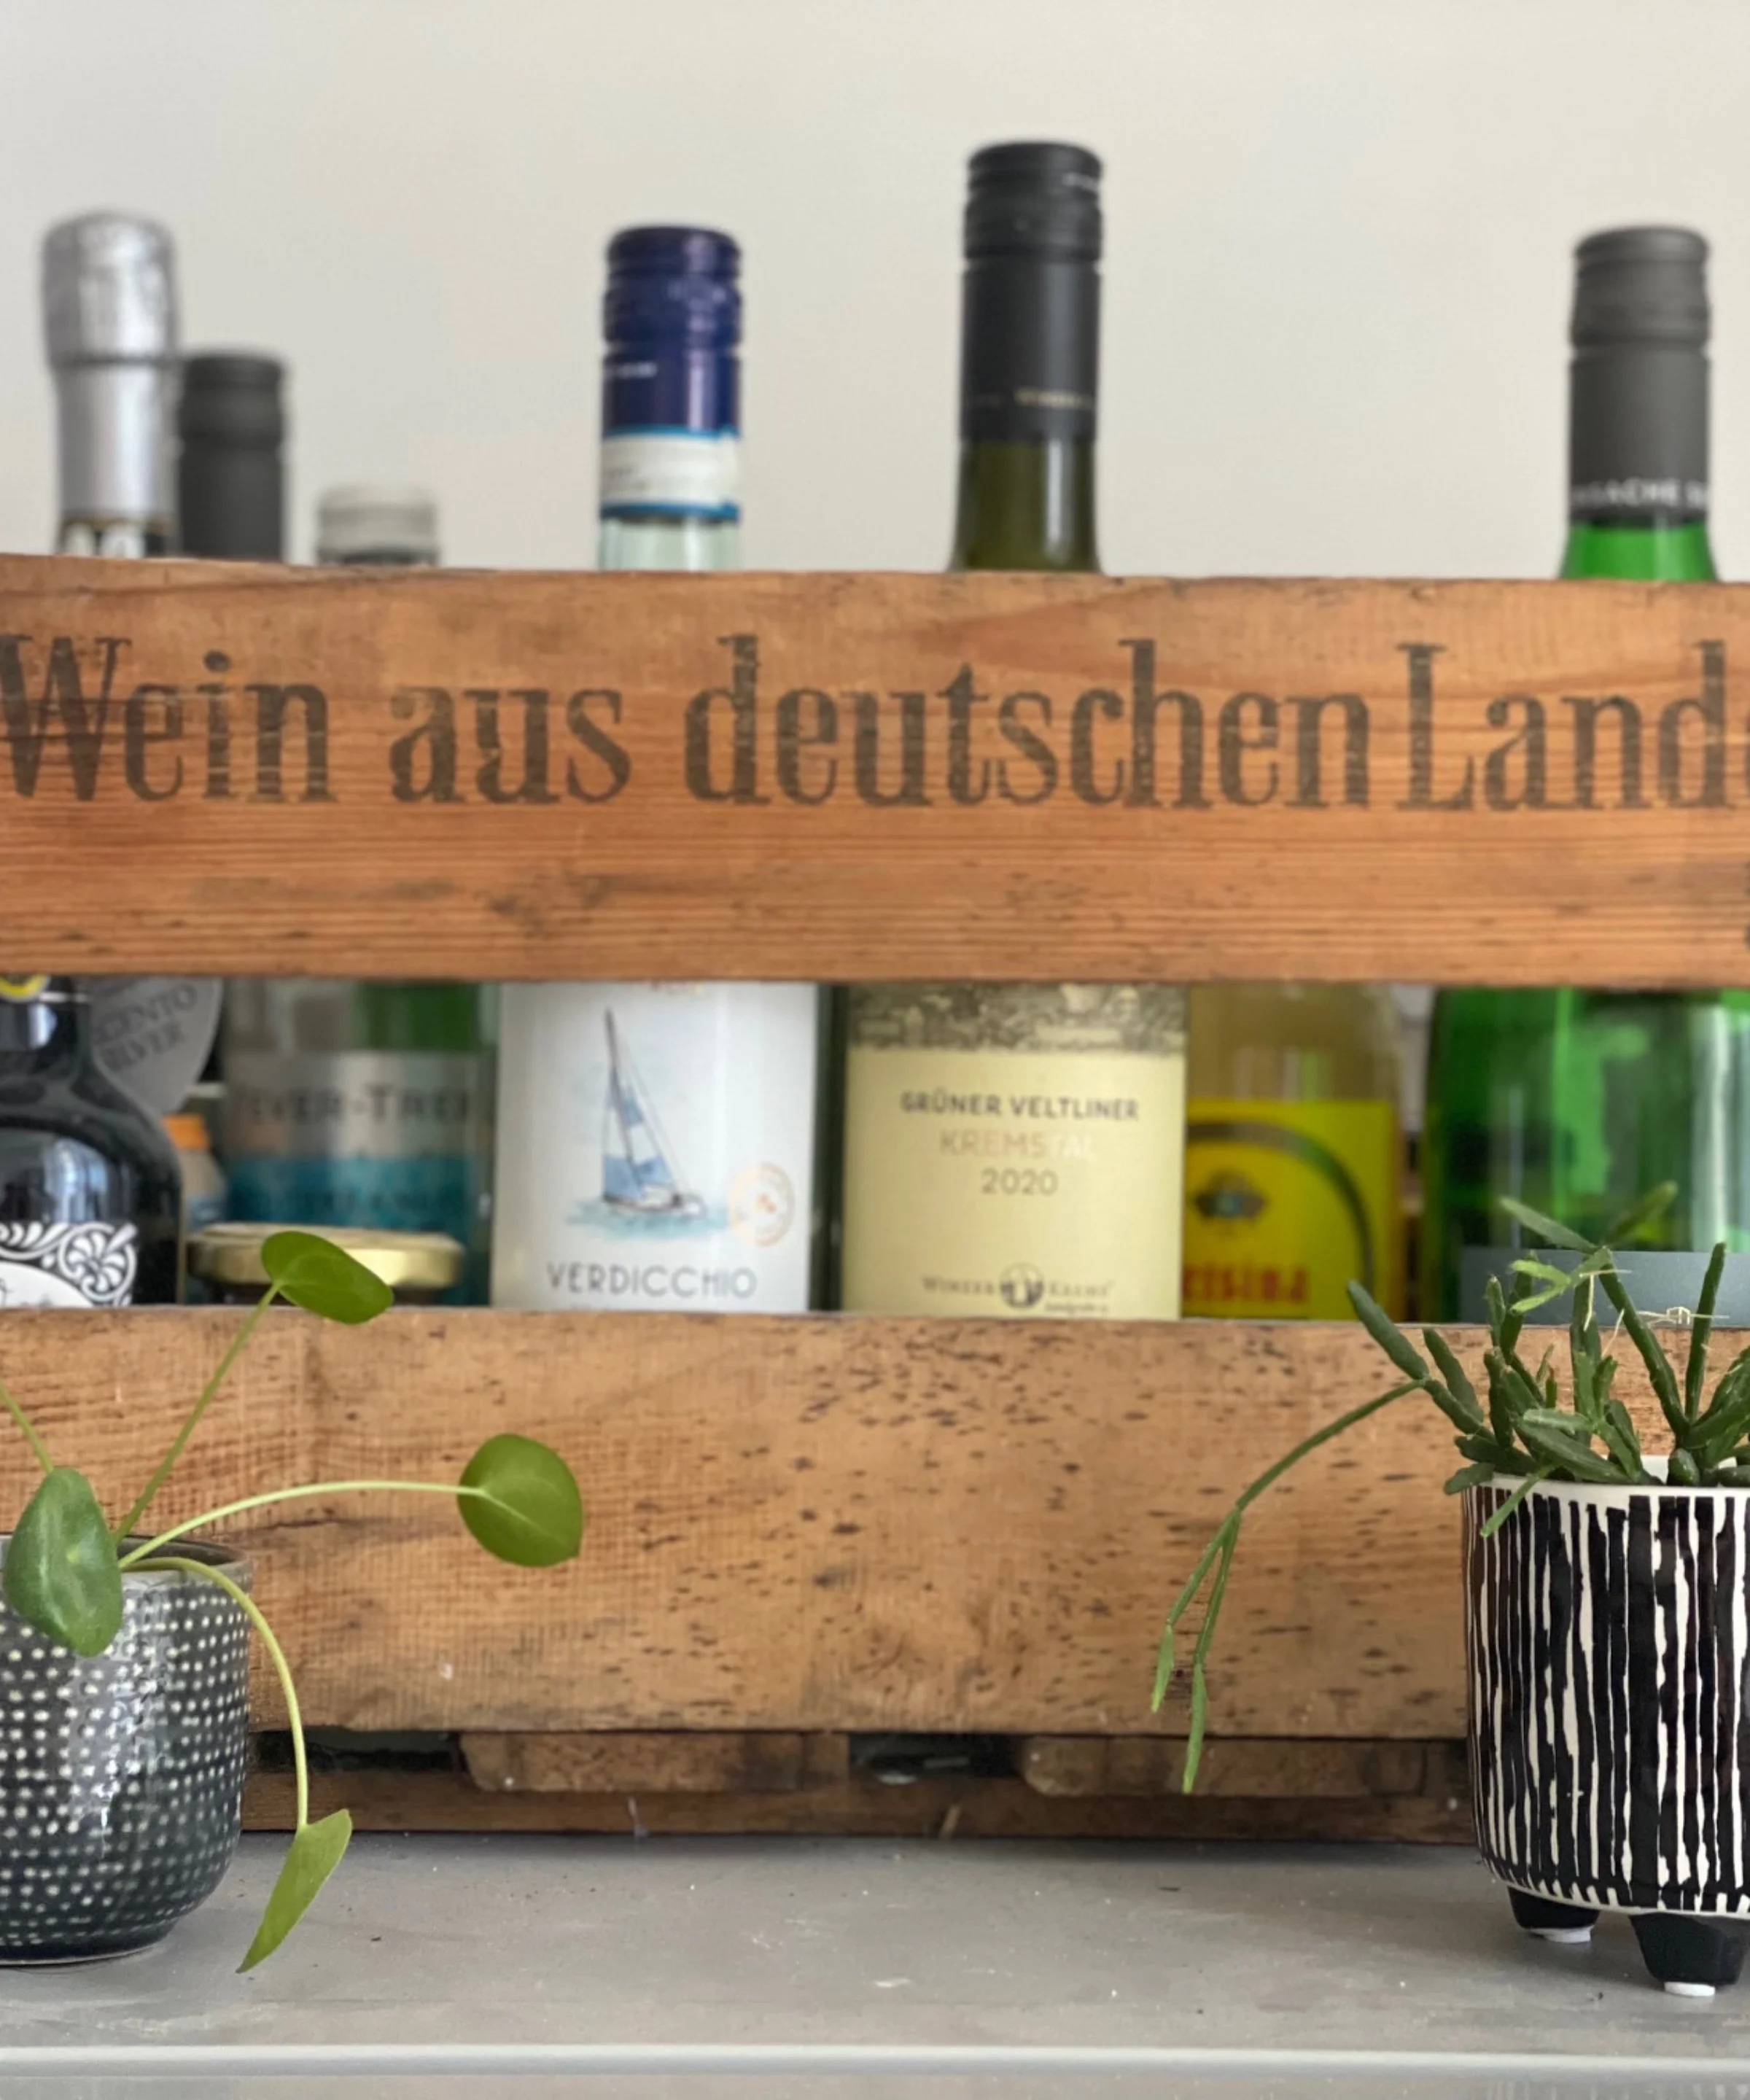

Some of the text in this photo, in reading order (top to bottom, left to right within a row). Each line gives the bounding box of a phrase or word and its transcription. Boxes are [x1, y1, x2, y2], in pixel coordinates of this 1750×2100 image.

[0, 631, 1750, 812] Wein aus deutschen Land
[899, 1086, 1139, 1121] GRÜNER VELTLINER
[981, 1167, 1059, 1196] 2020
[545, 1261, 758, 1299] VERDICCHIO
